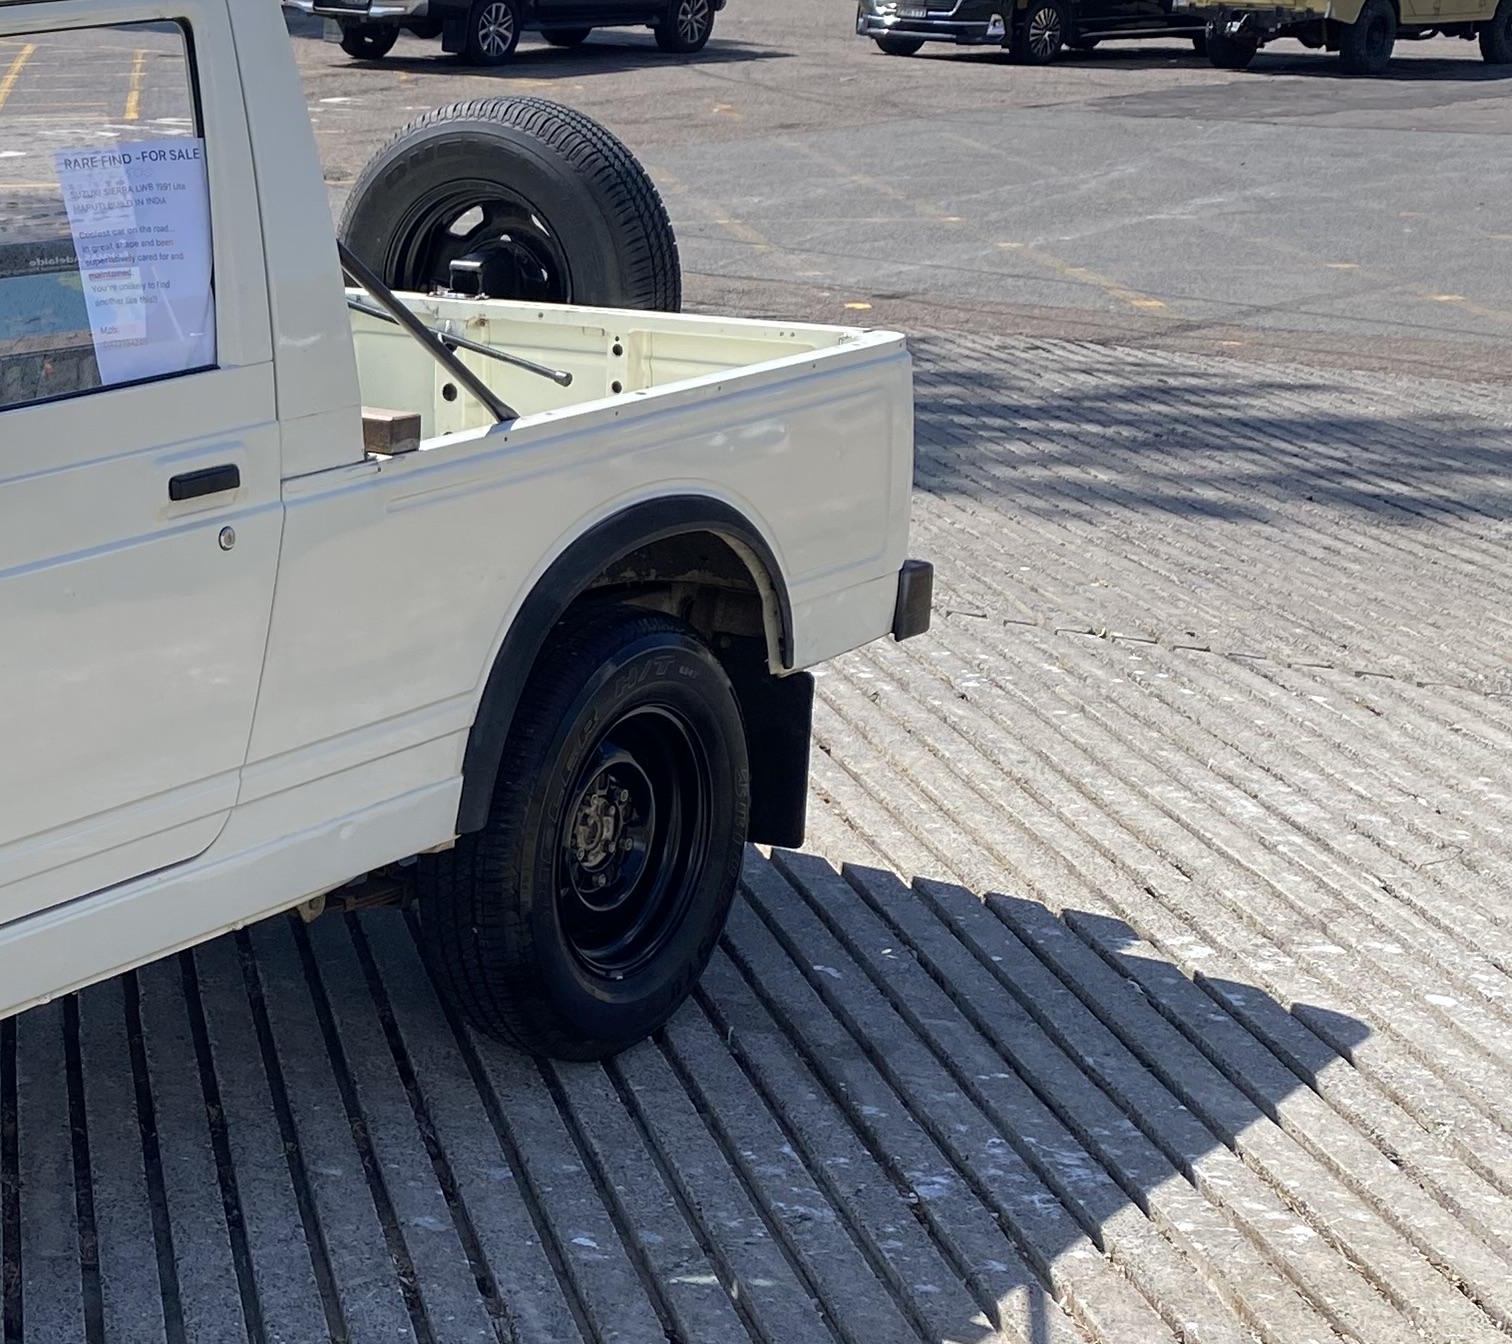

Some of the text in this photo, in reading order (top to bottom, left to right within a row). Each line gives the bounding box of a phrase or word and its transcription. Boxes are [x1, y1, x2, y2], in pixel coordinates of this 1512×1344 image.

[64, 157, 98, 170] RARE
[101, 153, 132, 167] FIND
[169, 148, 201, 160] SALE
[139, 225, 151, 233] the
[141, 239, 155, 247] and
